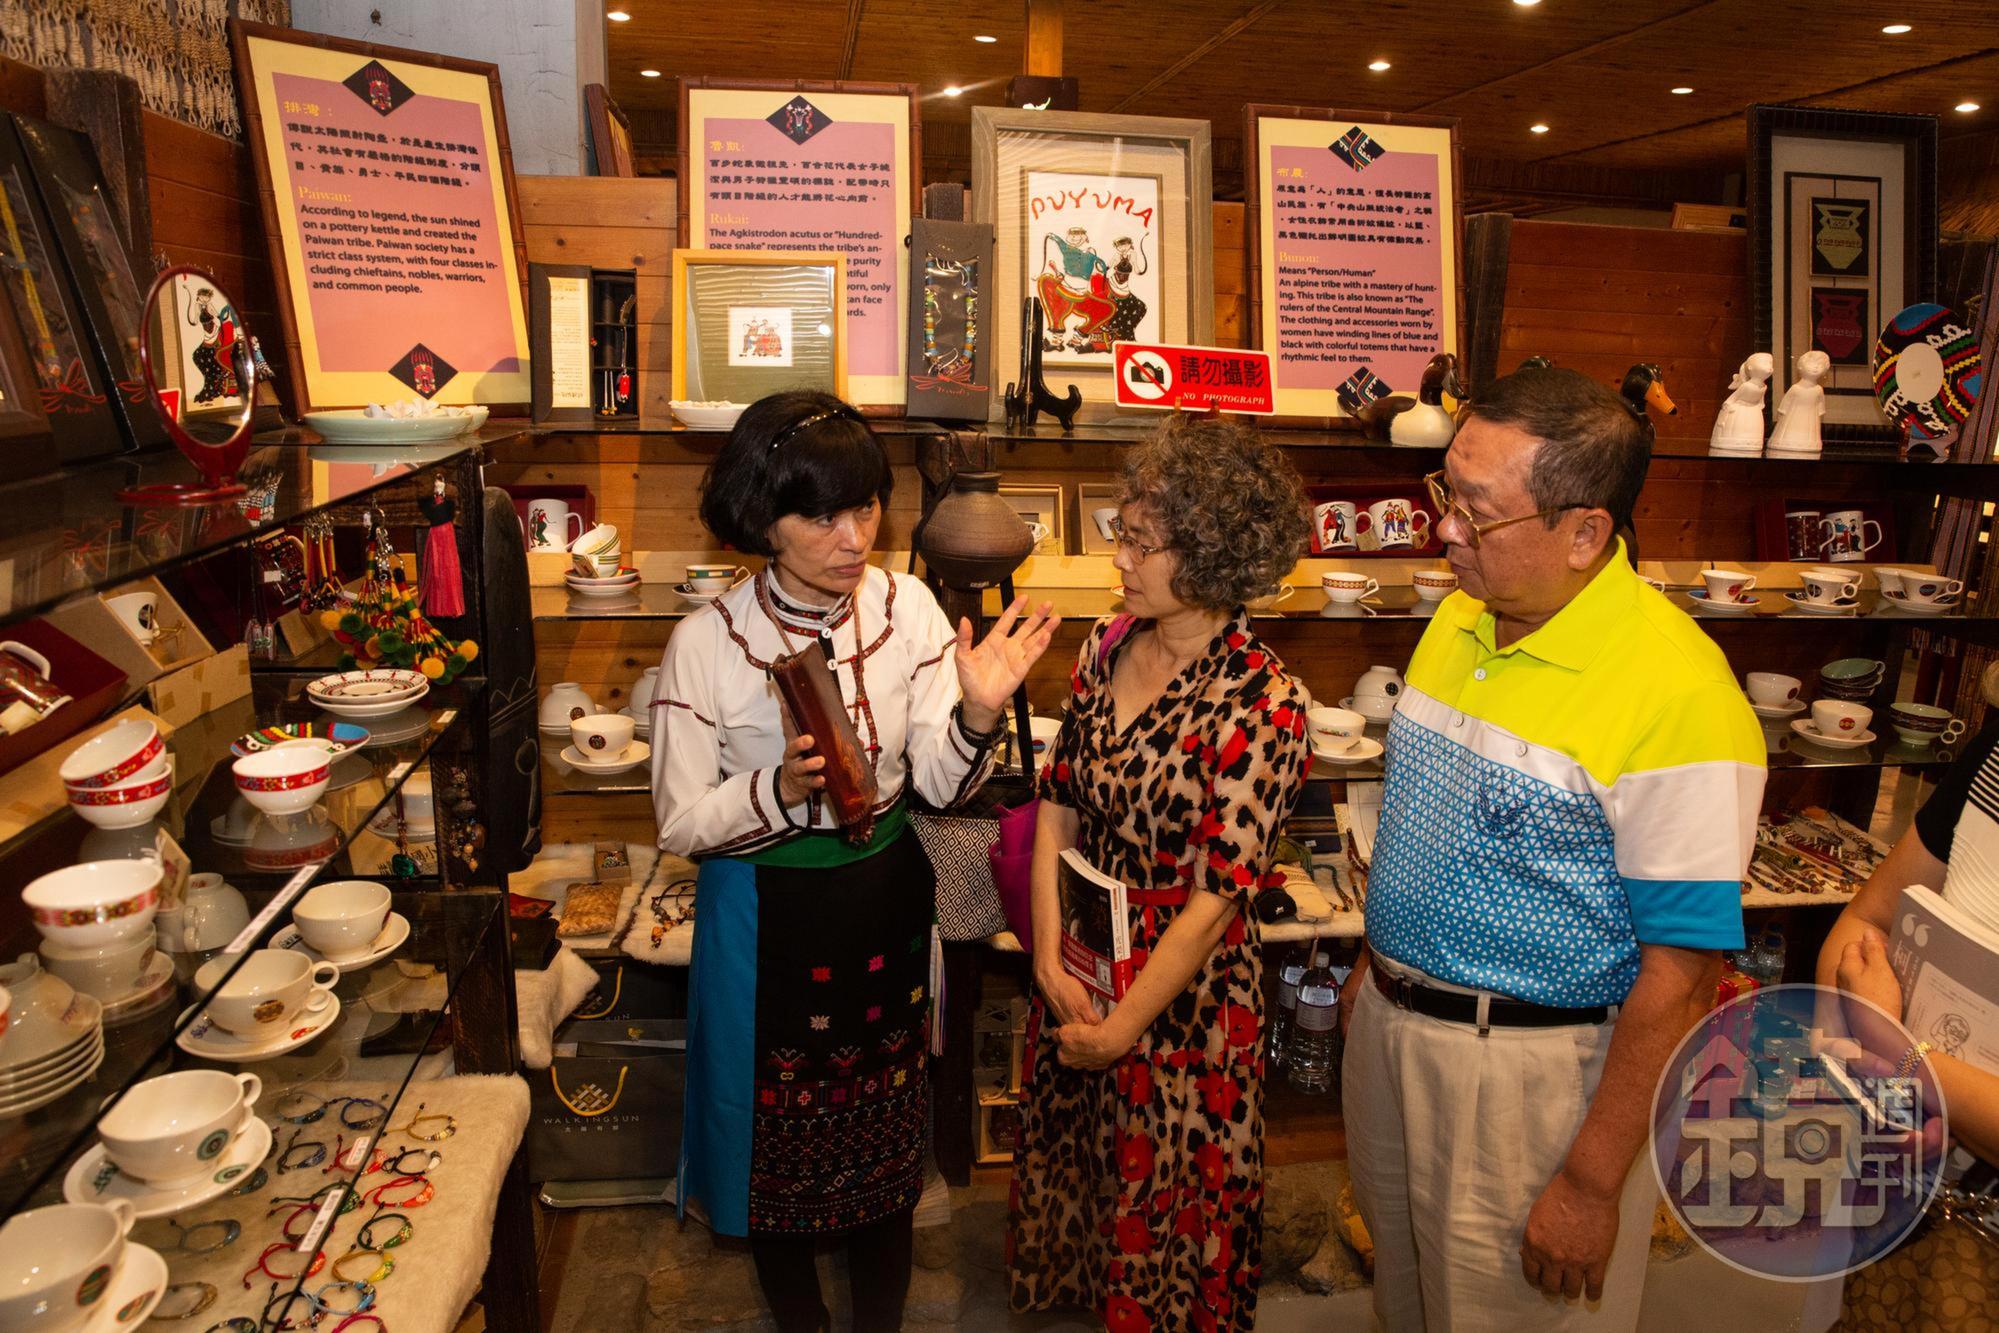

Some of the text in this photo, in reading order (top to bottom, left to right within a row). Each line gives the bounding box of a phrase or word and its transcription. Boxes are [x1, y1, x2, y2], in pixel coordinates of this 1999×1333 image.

[1031, 187, 1153, 228] PUYUMA
[301, 204, 356, 220] According
[358, 210, 369, 219] to
[411, 213, 428, 224] the
[430, 217, 448, 225] sun
[449, 216, 481, 228] shined
[710, 213, 750, 225] Rukai:
[303, 221, 477, 241] on a pottery kettle and created the
[710, 228, 728, 237] The
[729, 229, 788, 239] Agkistrodon
[789, 231, 821, 239] acutus
[305, 234, 345, 246] Paiwan
[376, 238, 413, 250] Paiwan
[414, 243, 449, 255] society
[450, 244, 468, 254] has
[469, 247, 475, 255] a
[818, 243, 835, 252] the
[307, 250, 336, 260] strict
[338, 251, 364, 262] class
[405, 256, 428, 265] with
[429, 256, 450, 267] four
[452, 258, 485, 269] classes
[853, 258, 881, 266] purity
[310, 264, 352, 278] cluding
[1279, 266, 1307, 275] Means
[313, 280, 334, 290] and
[336, 282, 383, 291] common
[870, 283, 891, 293] only
[1279, 279, 1291, 287] An
[1293, 279, 1320, 288] alpine
[1321, 280, 1342, 289] tribe
[1343, 281, 1362, 289] with
[1370, 283, 1404, 293] mastery
[1404, 283, 1414, 291] of
[863, 296, 882, 304] face
[1297, 291, 1315, 300] This
[1316, 292, 1337, 300] tribe
[1338, 293, 1345, 301] is
[1346, 293, 1364, 302] also
[1365, 294, 1394, 303] known
[1280, 303, 1304, 312] rulers
[1305, 303, 1315, 312] of
[1316, 304, 1331, 313] the
[1332, 305, 1363, 314] Central
[1364, 306, 1404, 315] Mountain
[1280, 315, 1296, 324] The
[1297, 316, 1333, 327] clothing
[1334, 317, 1351, 326] and
[1352, 319, 1399, 327] accessories
[1423, 320, 1433, 330] by
[1280, 329, 1439, 341] women have winding lines of blue and
[1280, 340, 1304, 349] black
[1305, 341, 1324, 349] with
[1325, 341, 1359, 350] colorful
[1360, 343, 1389, 351] totems
[1390, 343, 1408, 352] that
[1409, 344, 1428, 352] have
[1281, 353, 1319, 362] rhythmic
[1320, 353, 1337, 362] feel
[1180, 355, 1264, 388] 請勿攝影
[1183, 392, 1265, 405] NO PHOTOGRAPH
[543, 1115, 640, 1126] WALKINGSUN
